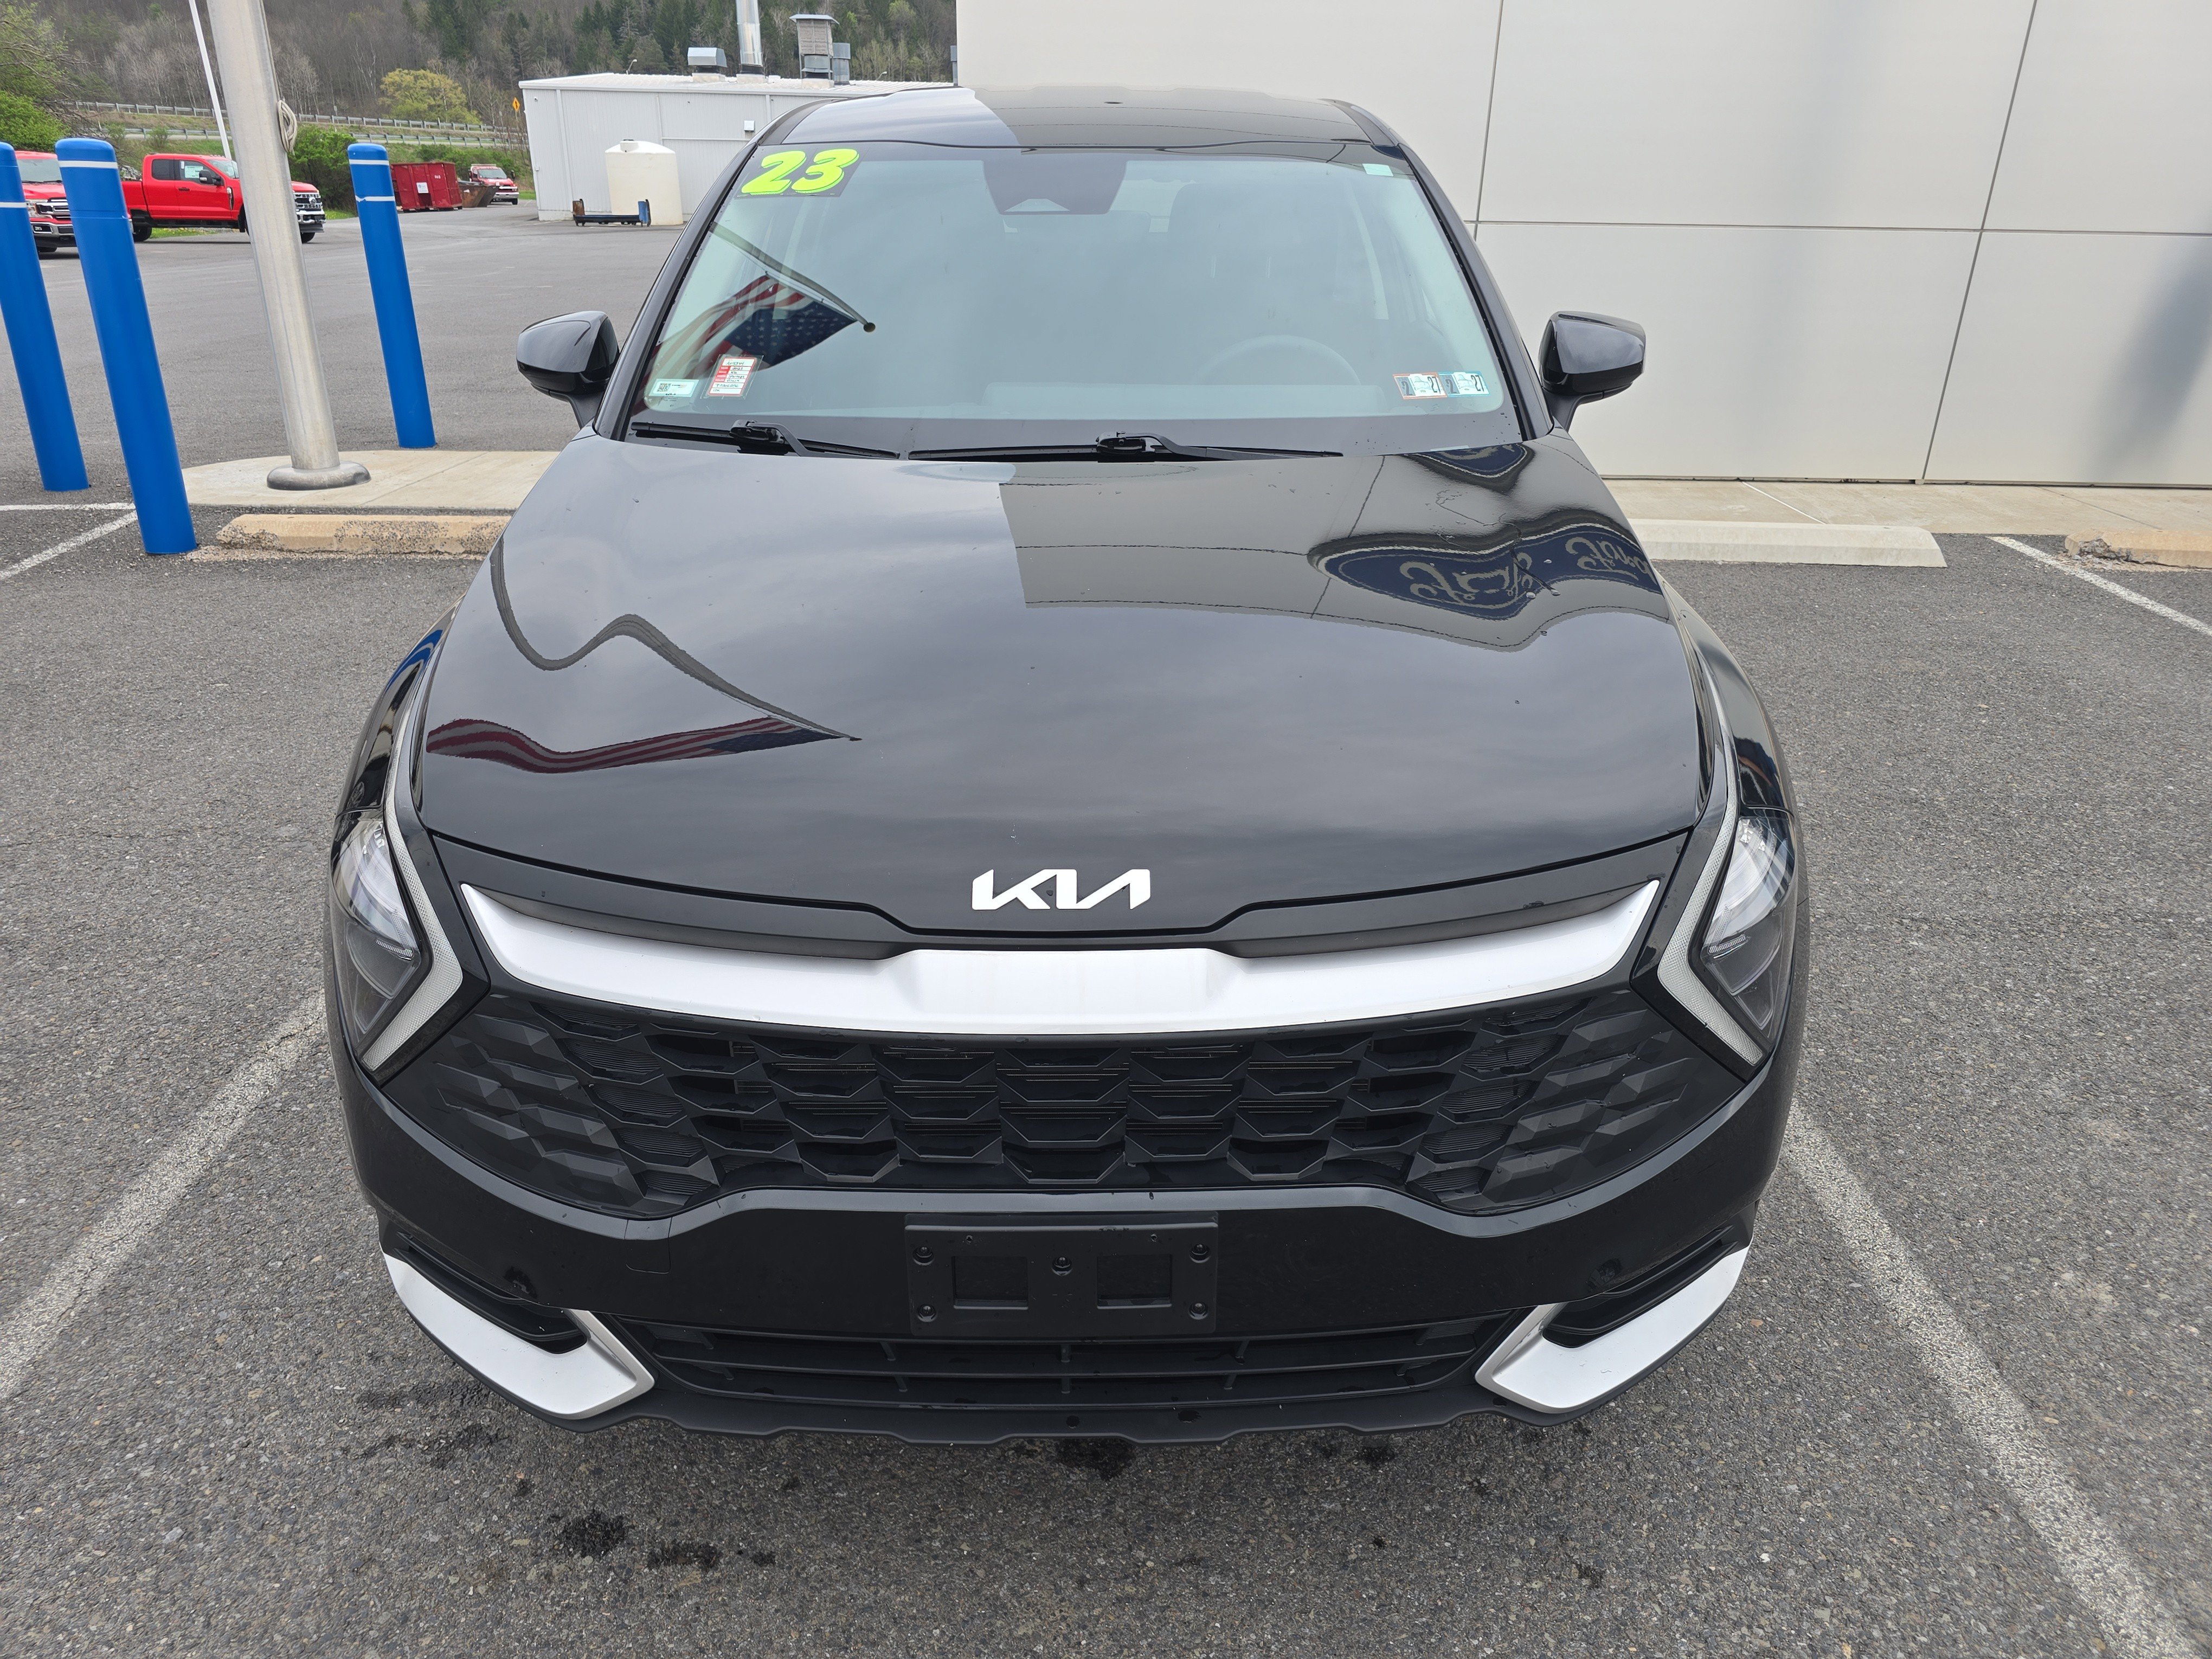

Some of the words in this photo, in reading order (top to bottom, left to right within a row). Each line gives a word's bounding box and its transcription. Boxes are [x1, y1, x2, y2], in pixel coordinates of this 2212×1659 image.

[742, 149, 859, 195] 23
[1427, 376, 1441, 394] 27
[1470, 375, 1484, 392] 27
[972, 869, 1150, 910] KIA
